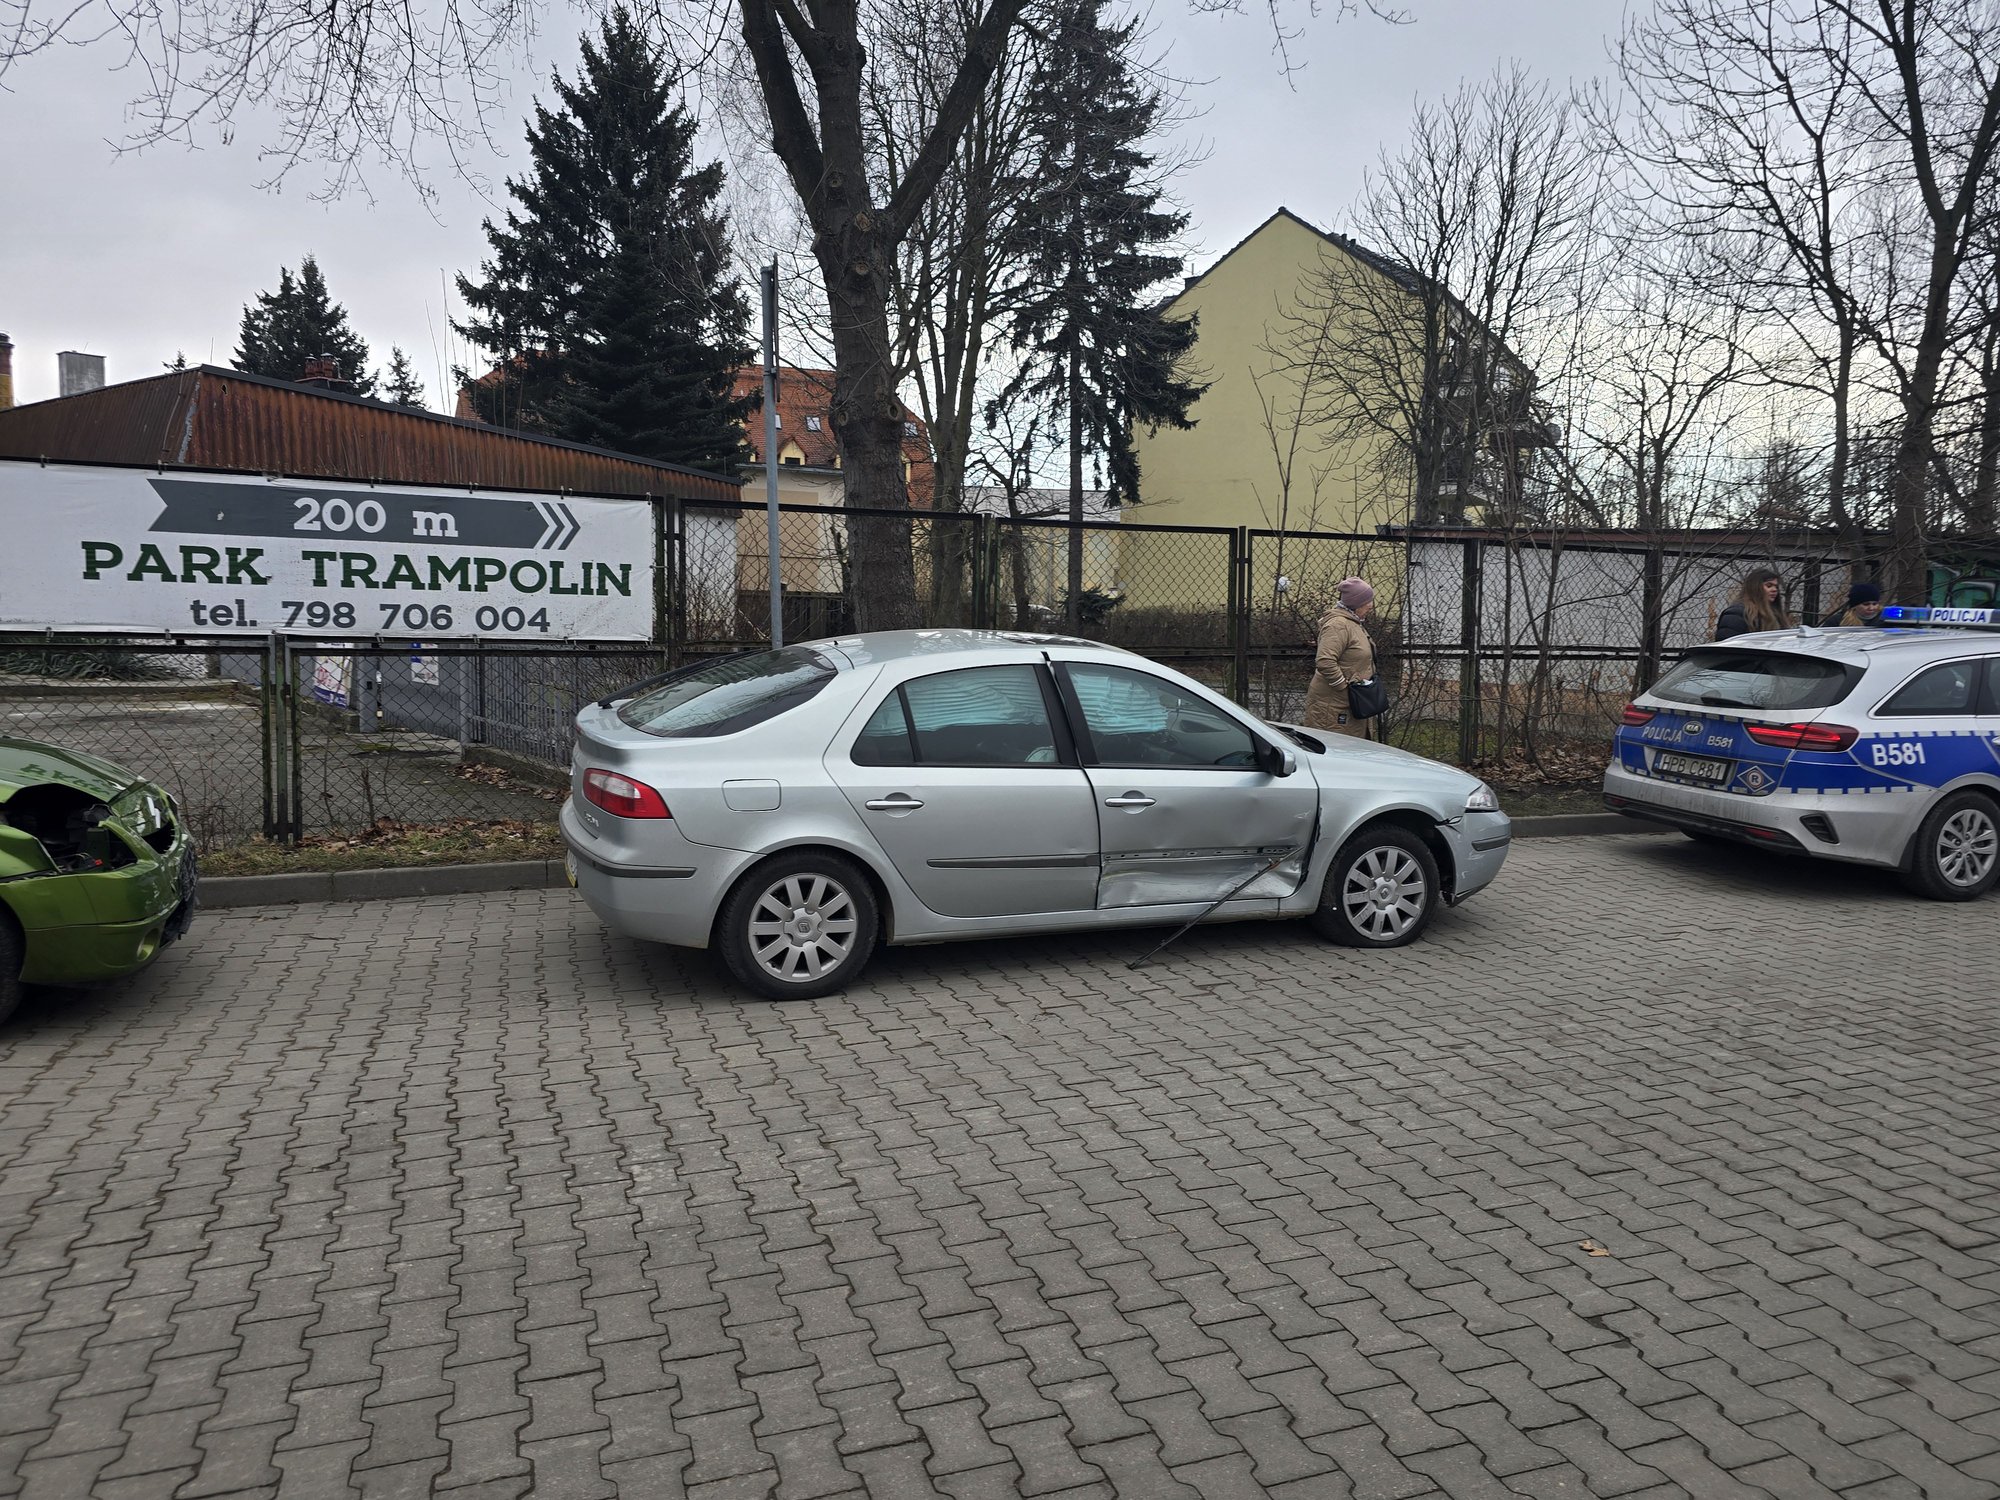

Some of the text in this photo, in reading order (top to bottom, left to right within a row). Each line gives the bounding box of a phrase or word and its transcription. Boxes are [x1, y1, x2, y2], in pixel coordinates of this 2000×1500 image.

[293, 497, 459, 537] 200 m
[81, 540, 632, 597] PARK TRAMPOLIN
[190, 599, 551, 633] tel. 798 706 004
[1934, 609, 1986, 623] POLICJA
[1641, 726, 1682, 743] POLICJA
[1685, 723, 1700, 733] KIA
[1706, 735, 1734, 748] B581
[1871, 742, 1926, 766] B581
[1662, 755, 1722, 779] HPB C881
